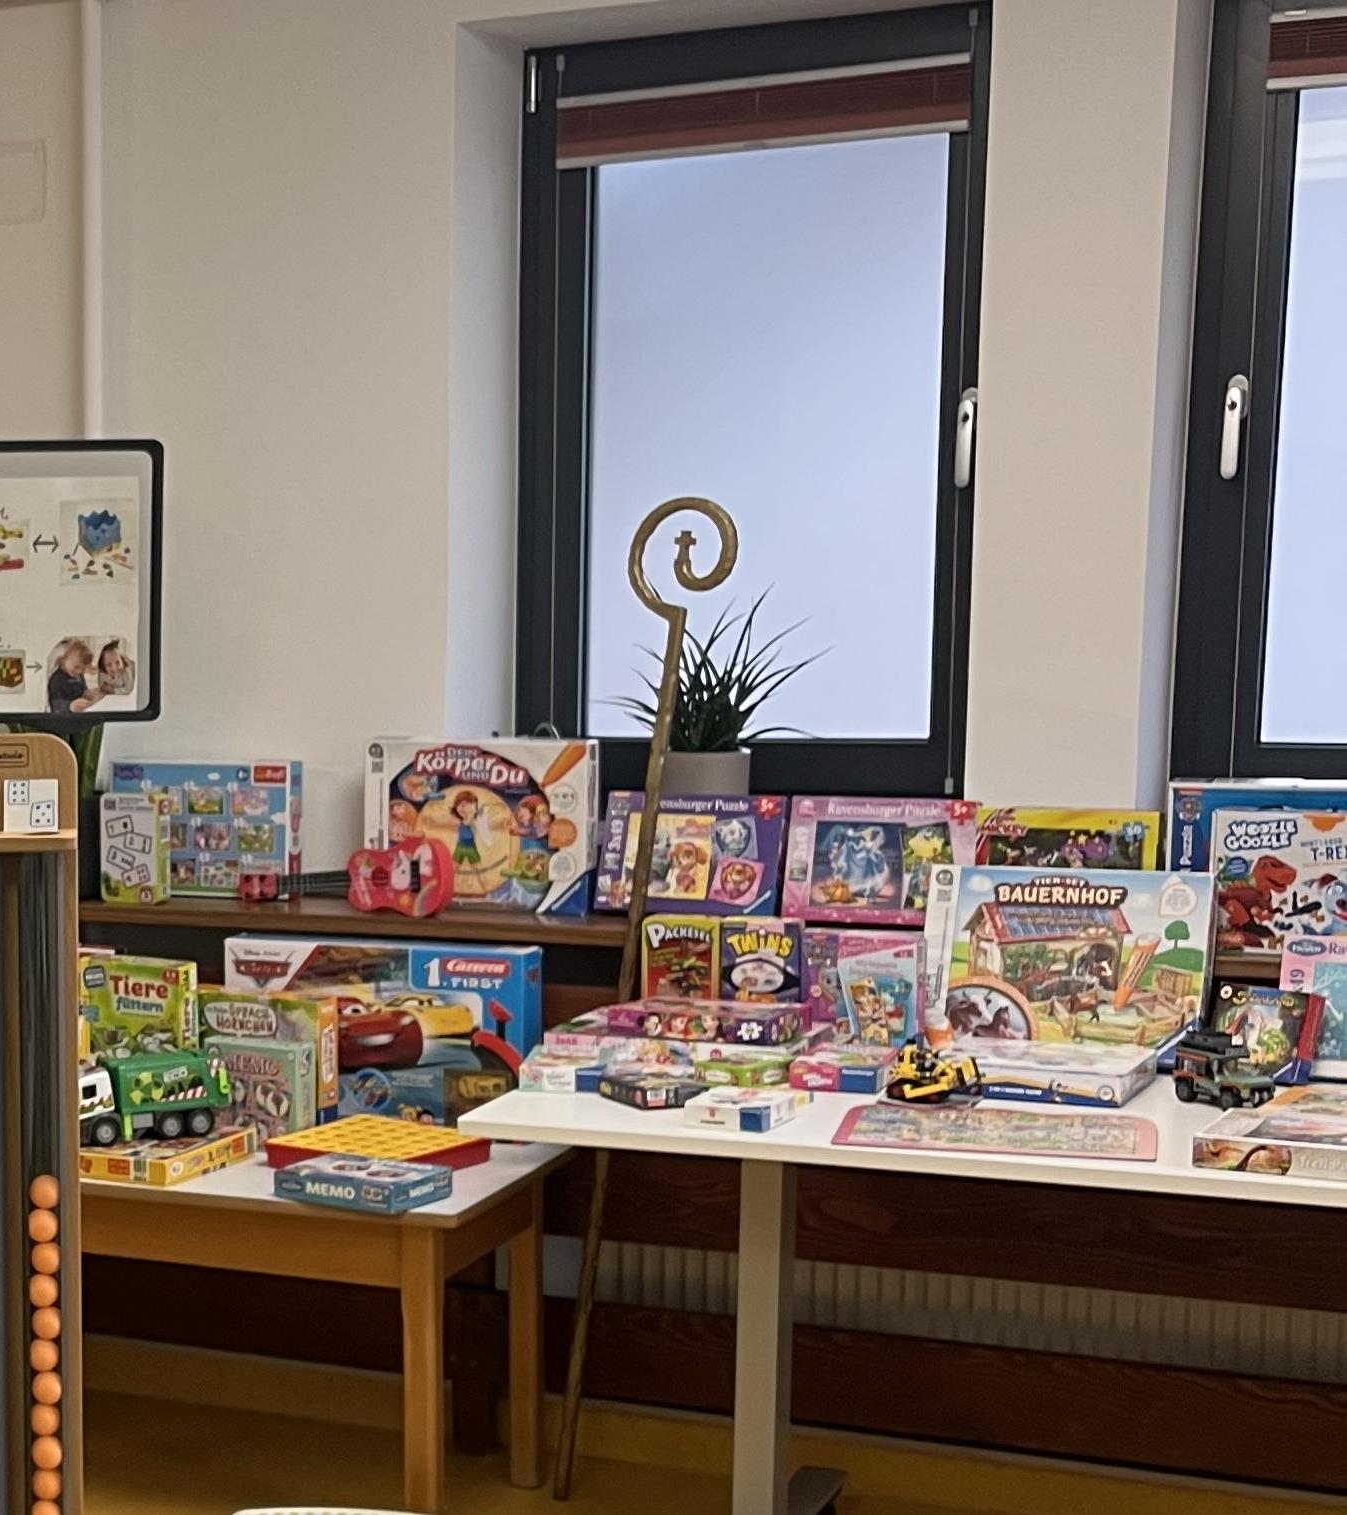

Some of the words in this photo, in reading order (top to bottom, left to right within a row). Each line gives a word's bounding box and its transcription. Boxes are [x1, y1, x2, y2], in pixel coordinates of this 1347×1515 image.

[416, 751, 496, 777] Körper
[489, 764, 526, 784] Du
[715, 799, 749, 811] Puzzle
[827, 802, 902, 817] Ravensburger
[1230, 820, 1297, 837] WOOZLE
[1225, 834, 1290, 850] GOOZLE
[998, 886, 1124, 905] BAUERNHOF
[446, 959, 506, 974] Carrera
[110, 975, 169, 998] Tiere
[116, 997, 164, 1012] füttern
[305, 1182, 356, 1200] MEMO
[409, 1182, 435, 1198] MEMO
